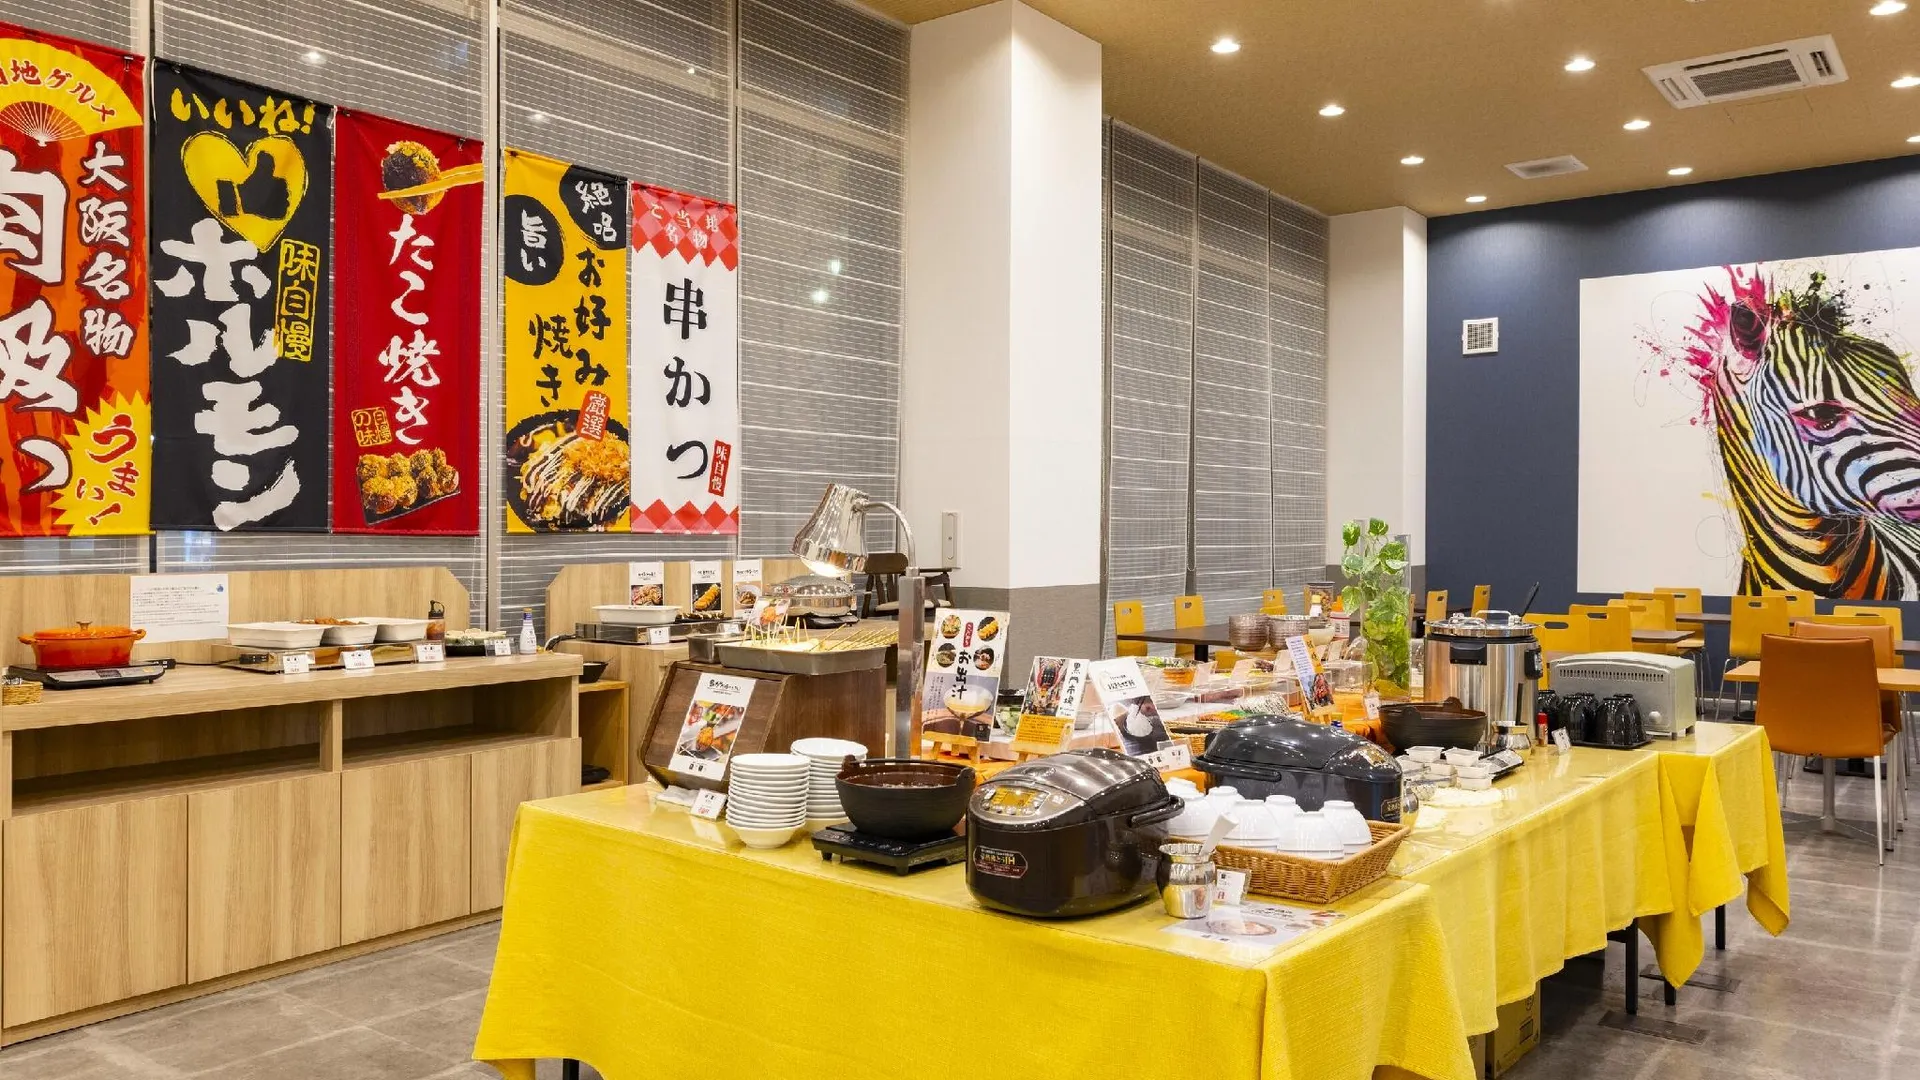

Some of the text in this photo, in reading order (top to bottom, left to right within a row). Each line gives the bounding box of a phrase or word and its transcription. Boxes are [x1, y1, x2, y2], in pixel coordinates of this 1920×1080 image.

[170, 87, 315, 135] いいね!
[520, 209, 549, 272] 旨い
[574, 181, 617, 243] 絶品
[651, 202, 719, 233] ご当地
[665, 221, 708, 249] 名物
[79, 140, 134, 357] 大阪名物
[281, 243, 317, 359] 味自慢
[378, 213, 441, 445] たこ焼き
[573, 247, 612, 387] お好み
[154, 217, 301, 531] ホルモン
[528, 313, 573, 407] 焼き
[663, 277, 712, 480] 串かつ
[580, 393, 607, 440] 厳選
[76, 413, 141, 527] うまい!
[711, 445, 728, 492] 味自慢
[951, 649, 972, 700] お出汁
[1063, 662, 1082, 706] 黒門市場
